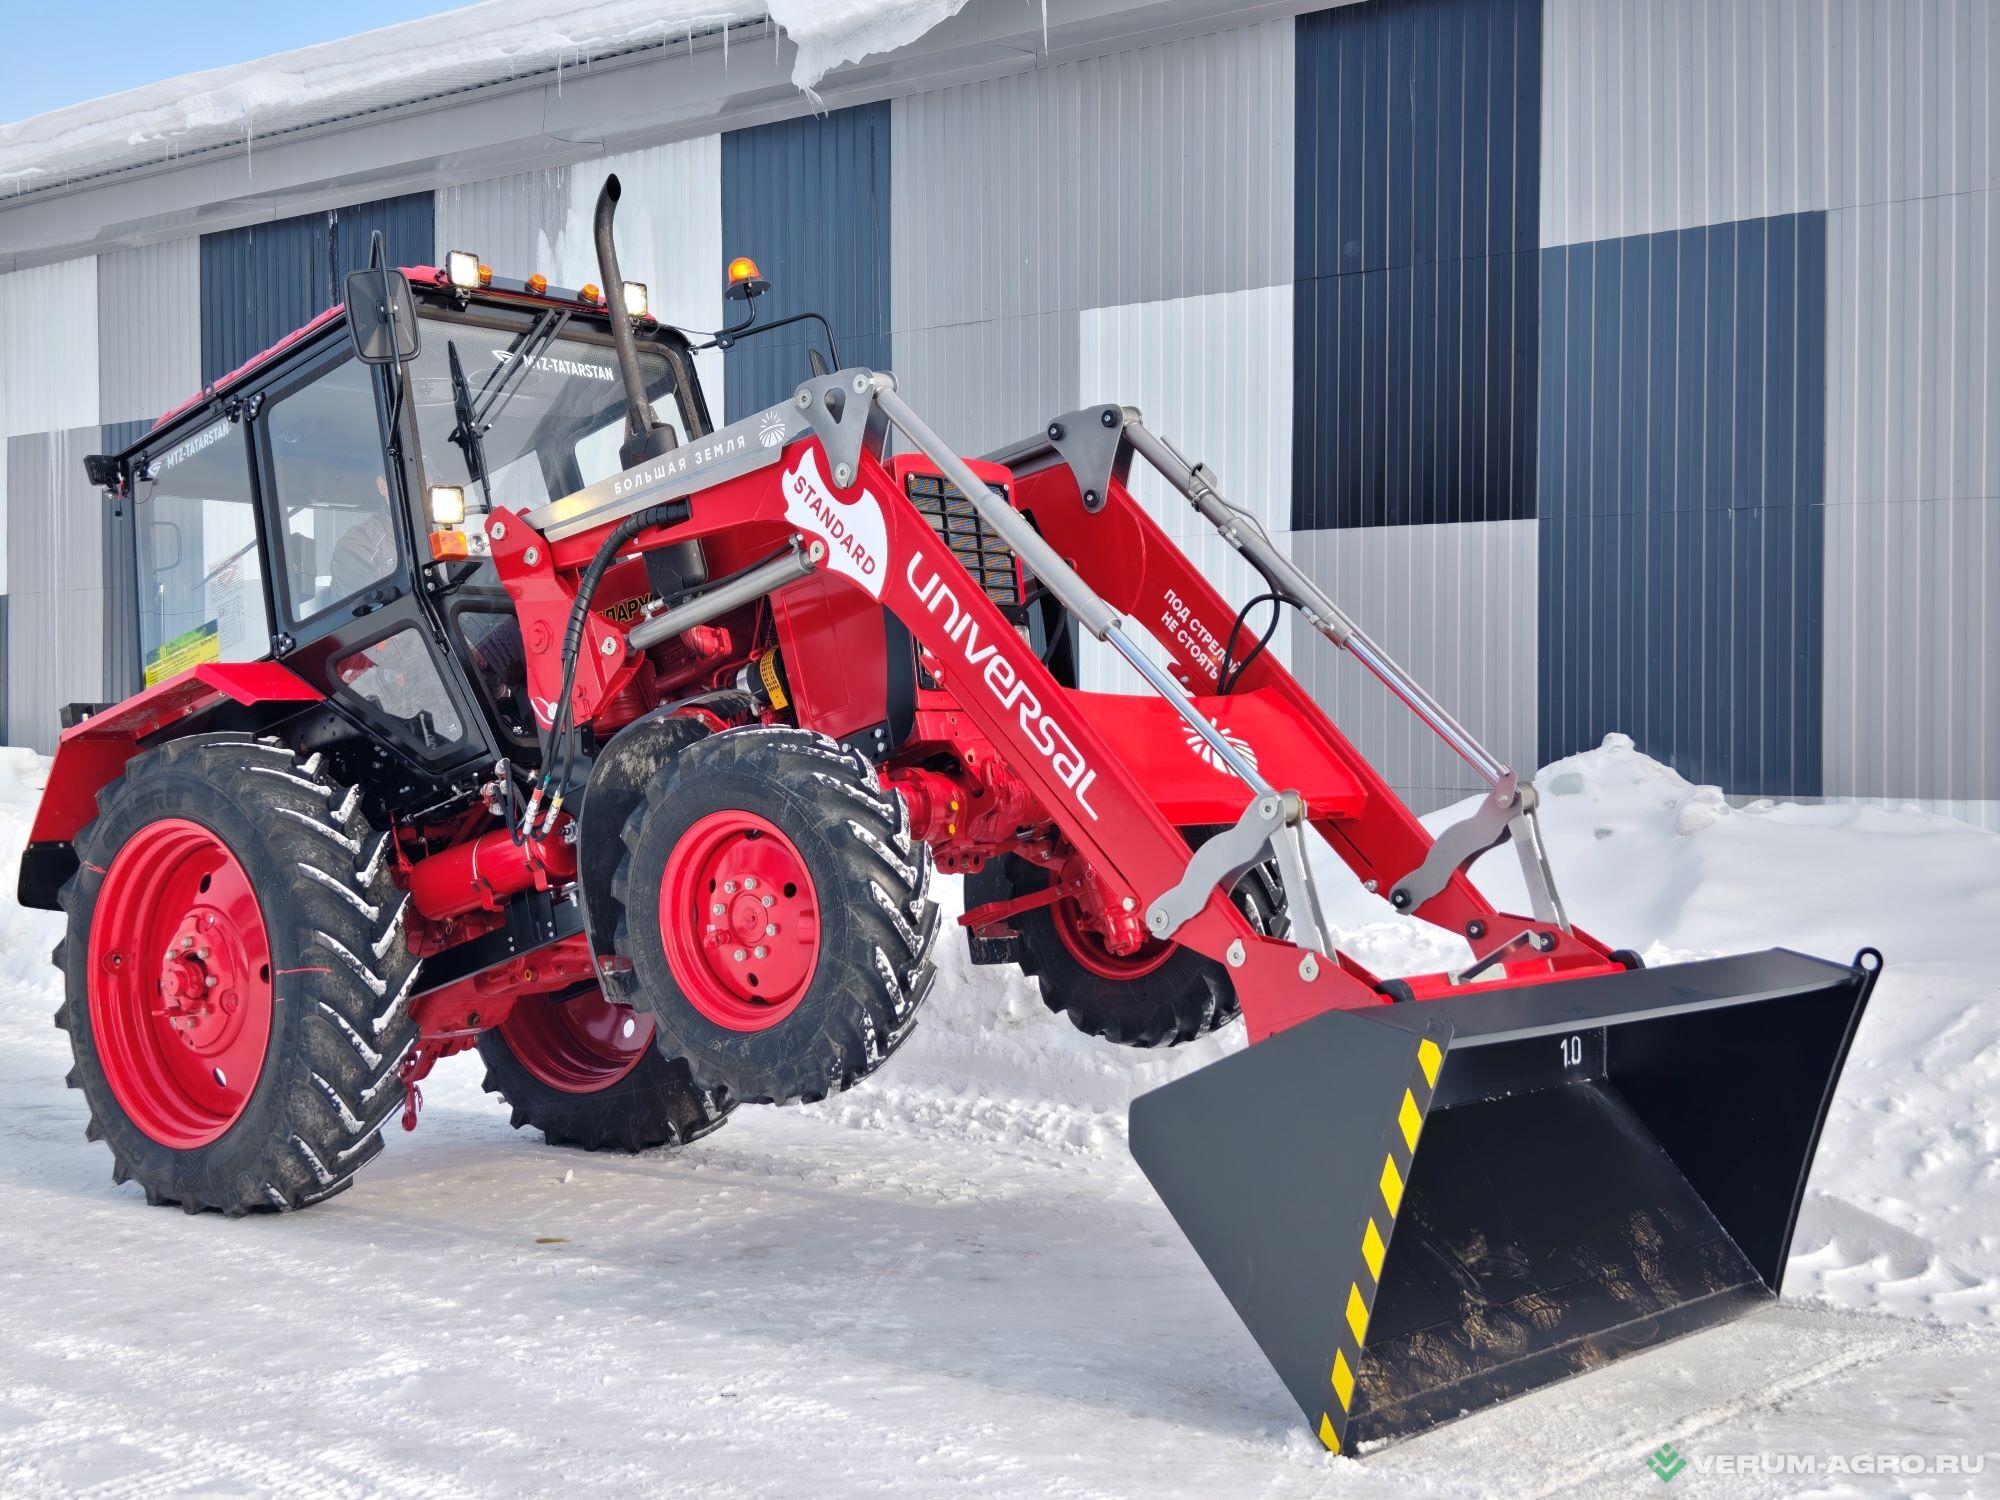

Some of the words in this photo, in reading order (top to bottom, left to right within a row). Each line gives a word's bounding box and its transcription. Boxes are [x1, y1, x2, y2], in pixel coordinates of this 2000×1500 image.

[523, 354, 615, 381] MTZ-TATARSTAN
[166, 420, 230, 469] MTZ-TATARSTAN
[613, 457, 687, 495] БОЛЬШАЯ
[694, 435, 746, 465] ЗЕМЛЯ
[793, 475, 876, 575] STANDARD
[1163, 588, 1191, 624] ПОД
[1160, 610, 1180, 633] НЕ
[1177, 629, 1218, 680] СТОЯТЬ
[1560, 1035, 1582, 1070] 1.0
